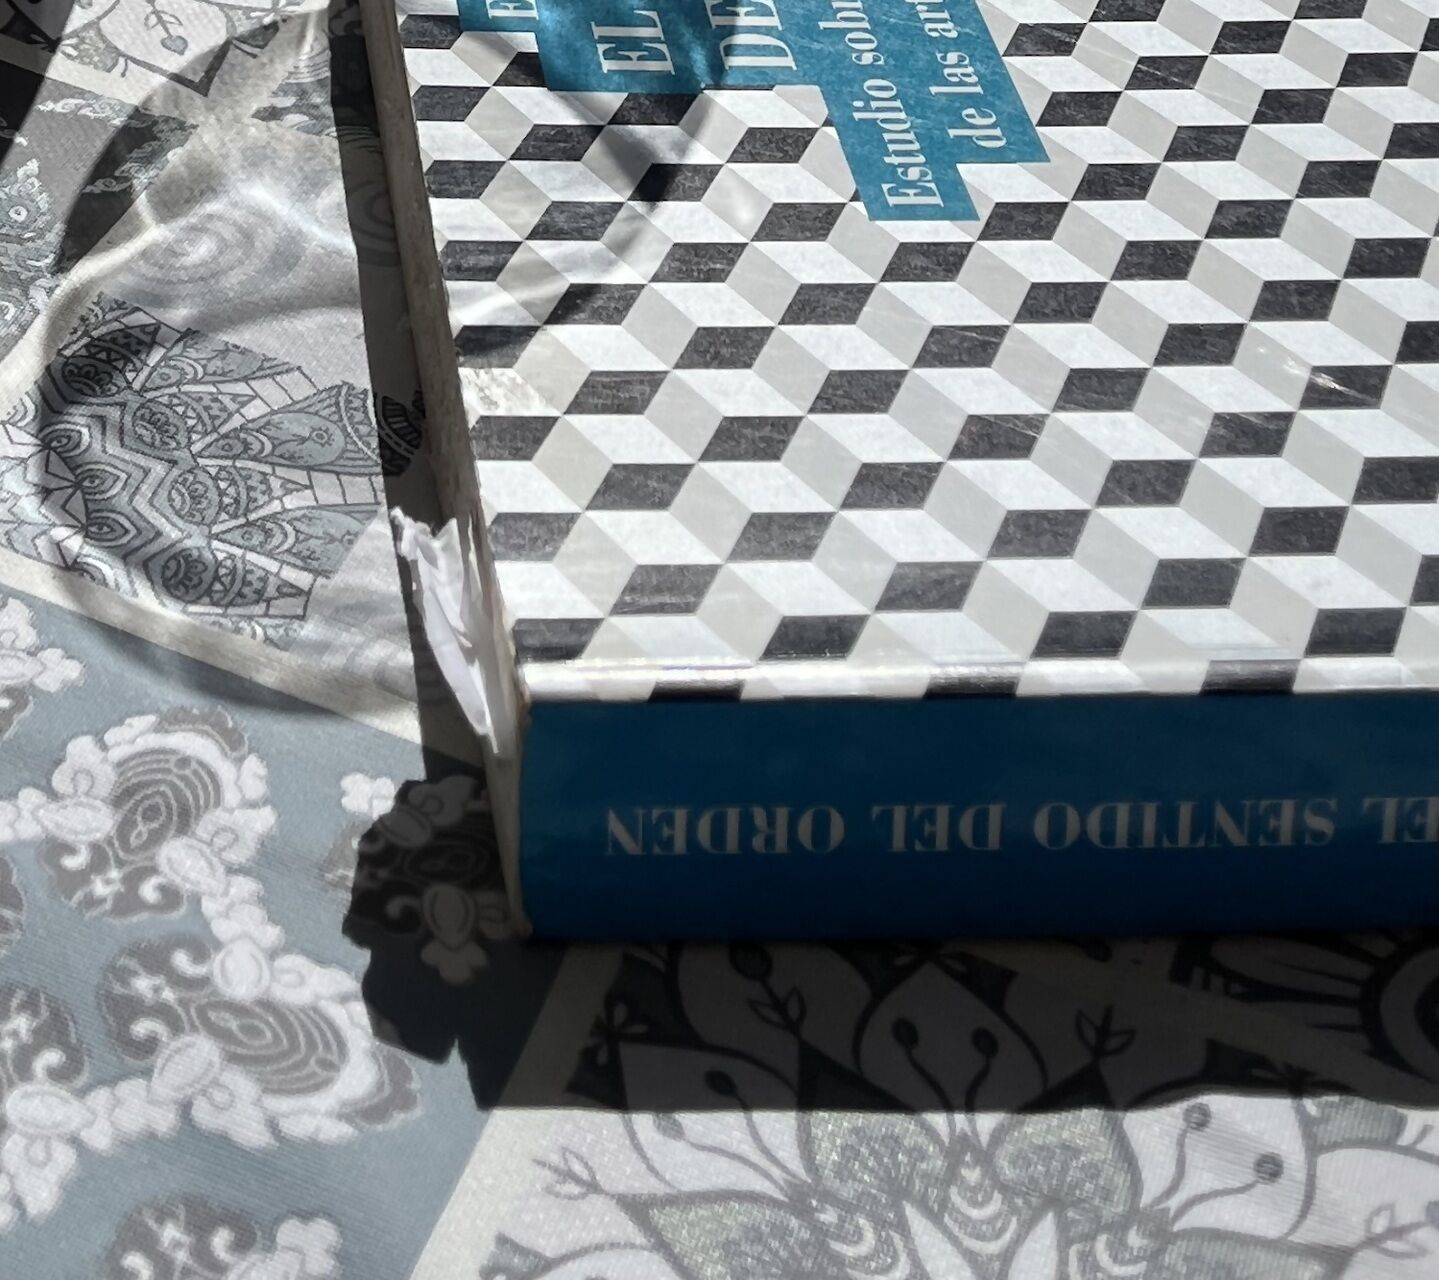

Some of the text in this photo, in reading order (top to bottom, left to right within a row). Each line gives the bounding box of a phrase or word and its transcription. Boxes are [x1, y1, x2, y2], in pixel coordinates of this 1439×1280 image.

[590, 10, 676, 75] EL
[928, 50, 984, 96] las
[852, 78, 944, 208] Estudio
[945, 107, 1007, 148] de
[604, 795, 1439, 856] EL SENTIDO DEL ORDEN
